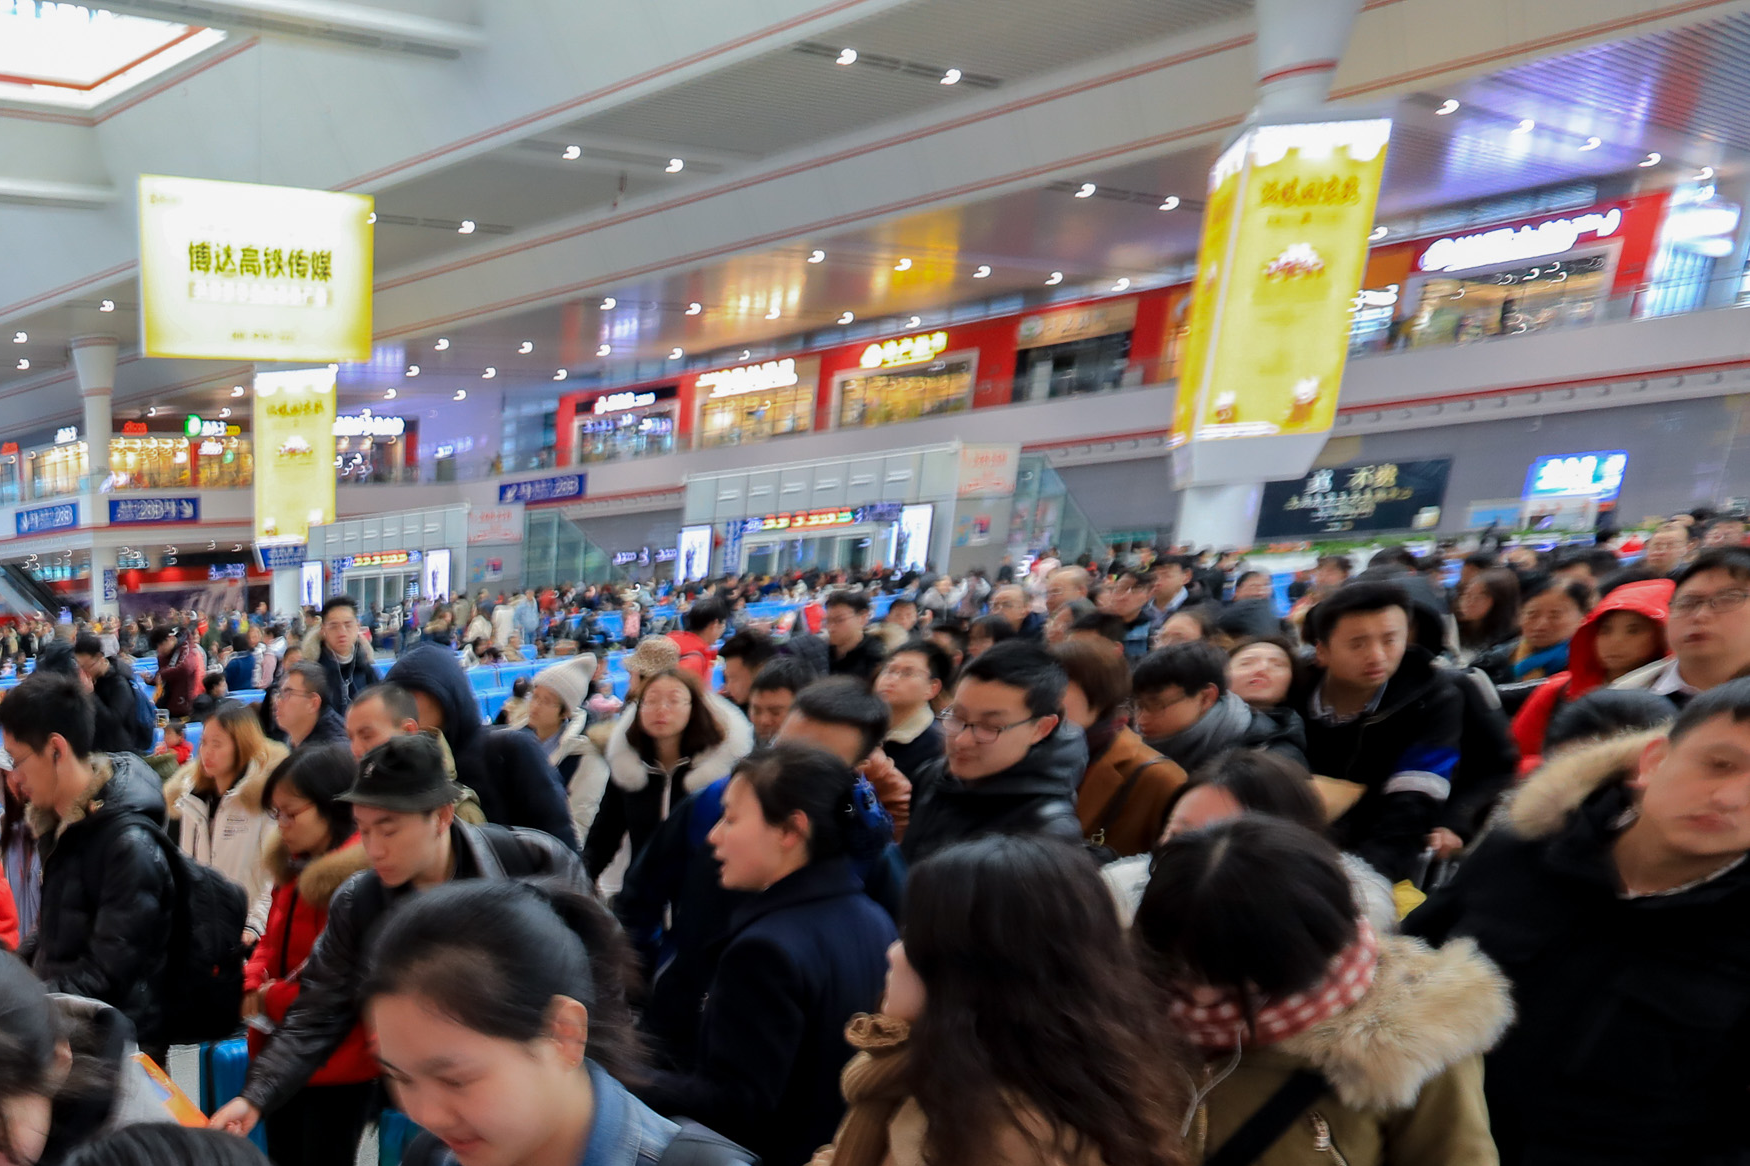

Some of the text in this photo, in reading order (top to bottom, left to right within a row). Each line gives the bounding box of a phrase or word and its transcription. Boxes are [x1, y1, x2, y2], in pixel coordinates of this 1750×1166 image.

[189, 241, 332, 281] 博达高铁传媒
